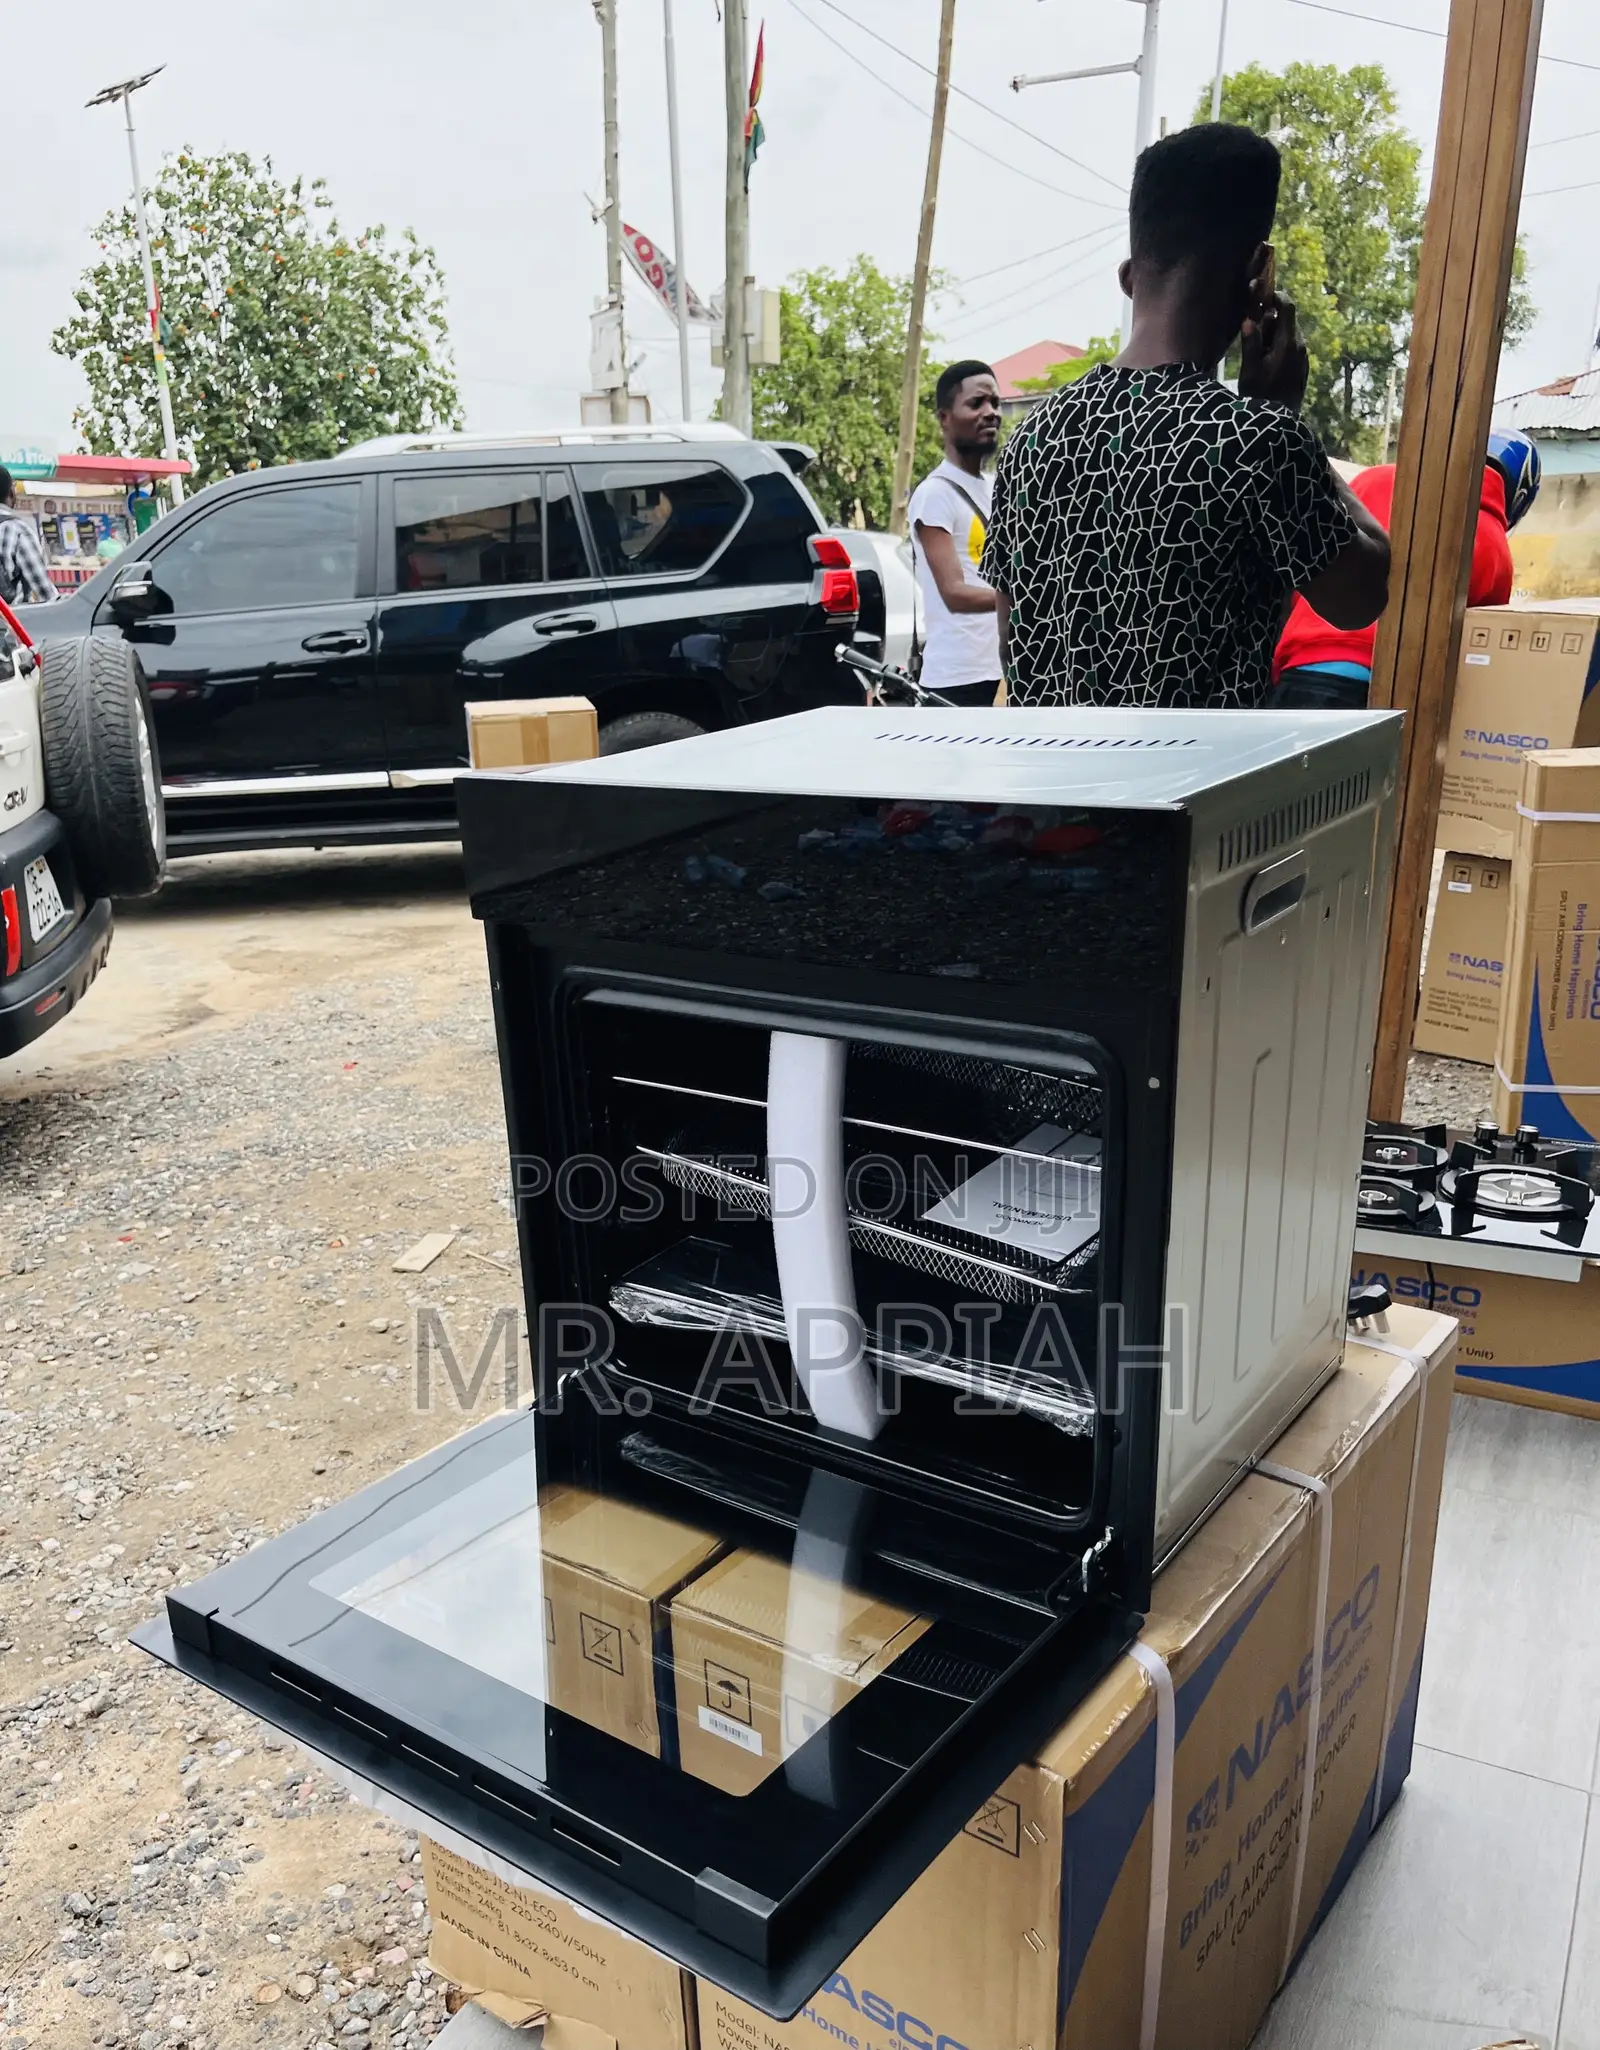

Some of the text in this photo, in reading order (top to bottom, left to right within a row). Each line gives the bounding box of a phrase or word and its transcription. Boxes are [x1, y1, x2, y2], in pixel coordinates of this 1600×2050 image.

[1478, 731, 1549, 750] NASCO
[1559, 890, 1568, 911] SPLIT
[1557, 914, 1566, 928] AIR
[1463, 956, 1504, 972] NAS
[1552, 929, 1565, 984] CONDITIONER
[1565, 903, 1588, 1020] Bring Home Happiness
[992, 1200, 1072, 1222] USER MANUAL
[1465, 1347, 1494, 1360] Unit)
[1180, 1656, 1370, 1950] Bring Home Hppiness
[1196, 1713, 1356, 1972] SPLIT AIR CONTIONER
[431, 1851, 464, 1878] Power
[510, 1901, 607, 1968] 220-240V/50Hz
[477, 1893, 502, 1920] 24kg
[1230, 1840, 1292, 1947] (Outdoor
[440, 1910, 532, 1979] MADE IN CHINA
[582, 1975, 600, 1992] cm
[715, 2001, 760, 2040] Model:
[801, 2006, 860, 2050] Home
[822, 1972, 970, 2050] ASC
[716, 2017, 758, 2050] Power
